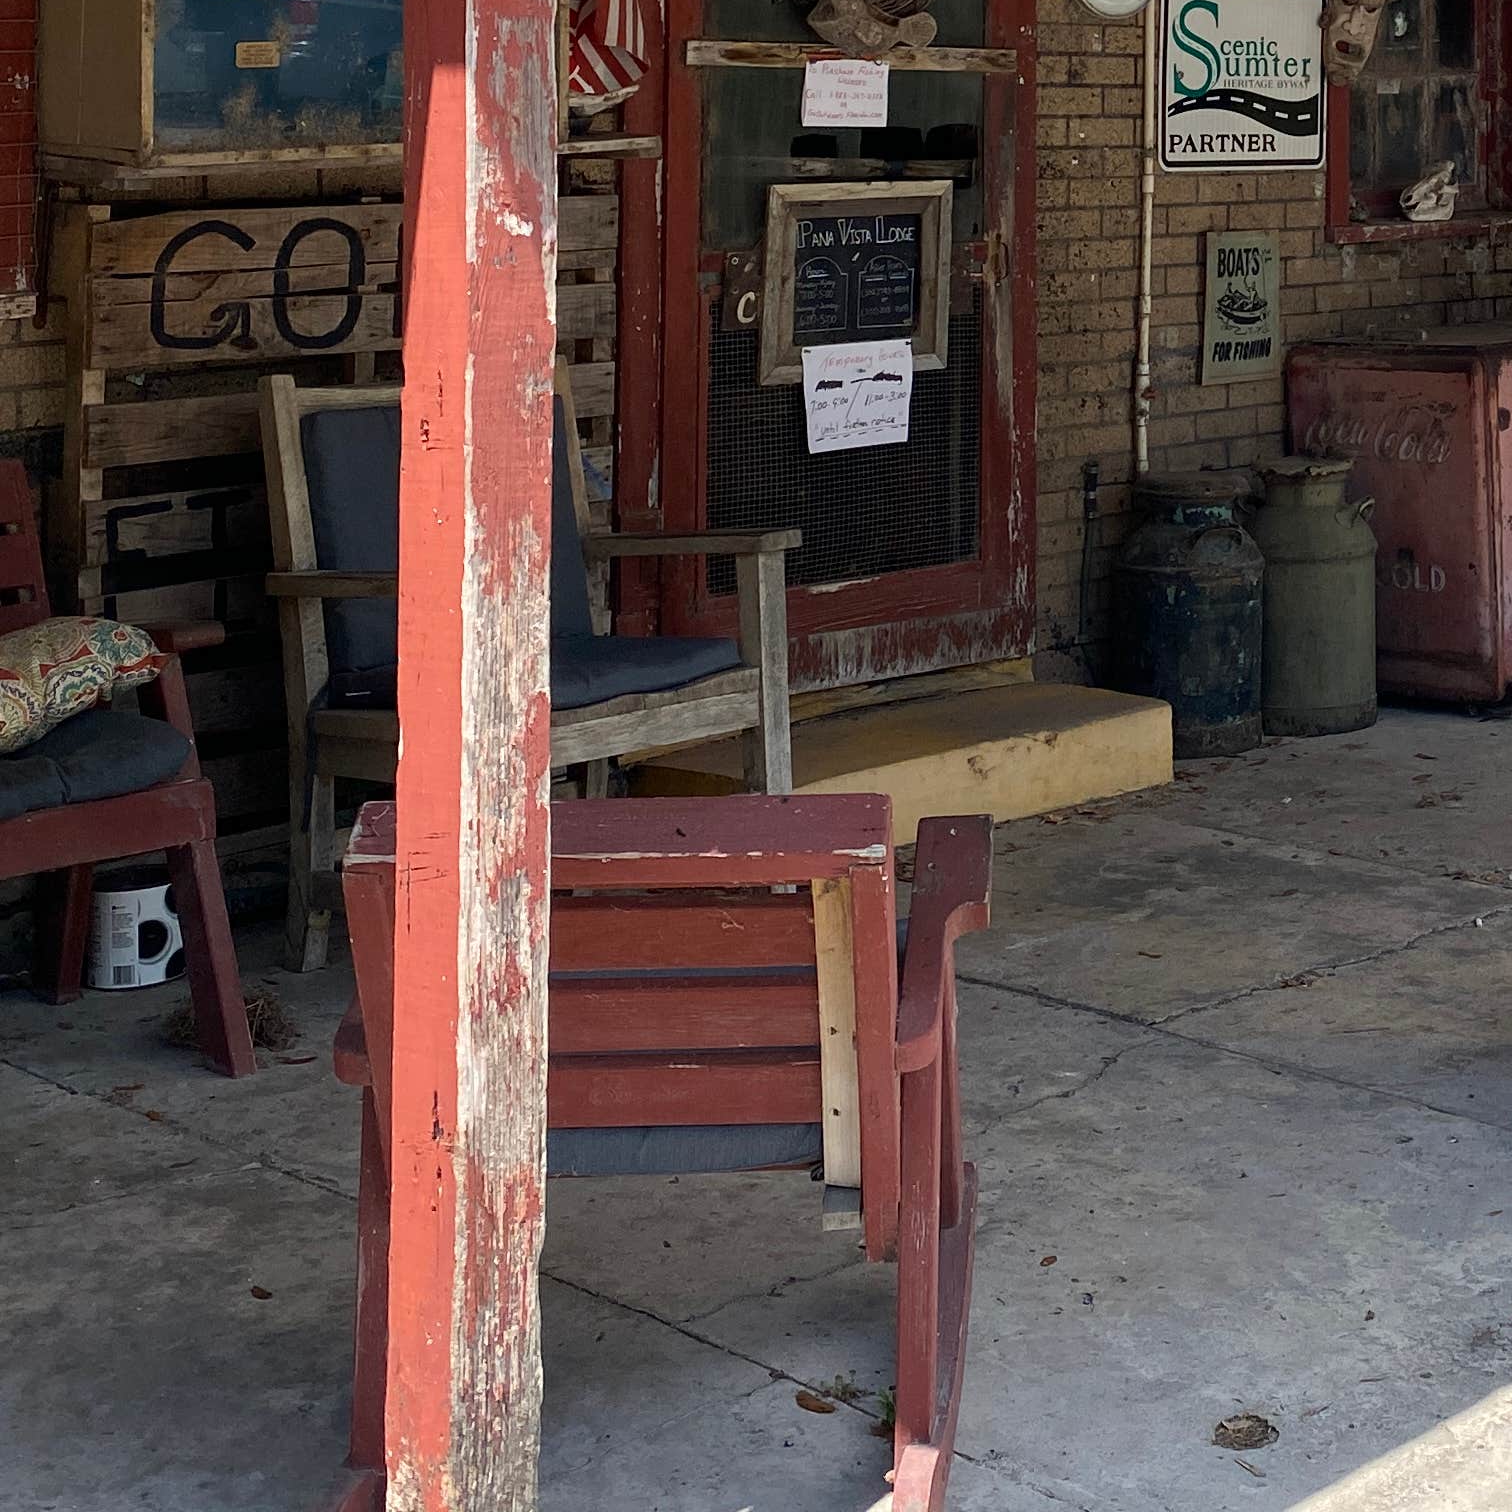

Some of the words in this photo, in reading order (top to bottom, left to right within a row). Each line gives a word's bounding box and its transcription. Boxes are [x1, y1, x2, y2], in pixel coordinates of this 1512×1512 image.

[1172, 0, 1278, 98] Scenic
[1222, 79, 1274, 89] HERITAGE
[1168, 134, 1277, 154] PARTNER
[796, 220, 835, 249] PANA
[837, 219, 873, 245] VISTA
[875, 215, 916, 244] LODGE
[1217, 247, 1261, 278] BOATS
[1212, 341, 1233, 363] FOR
[1233, 337, 1272, 362] FISHING
